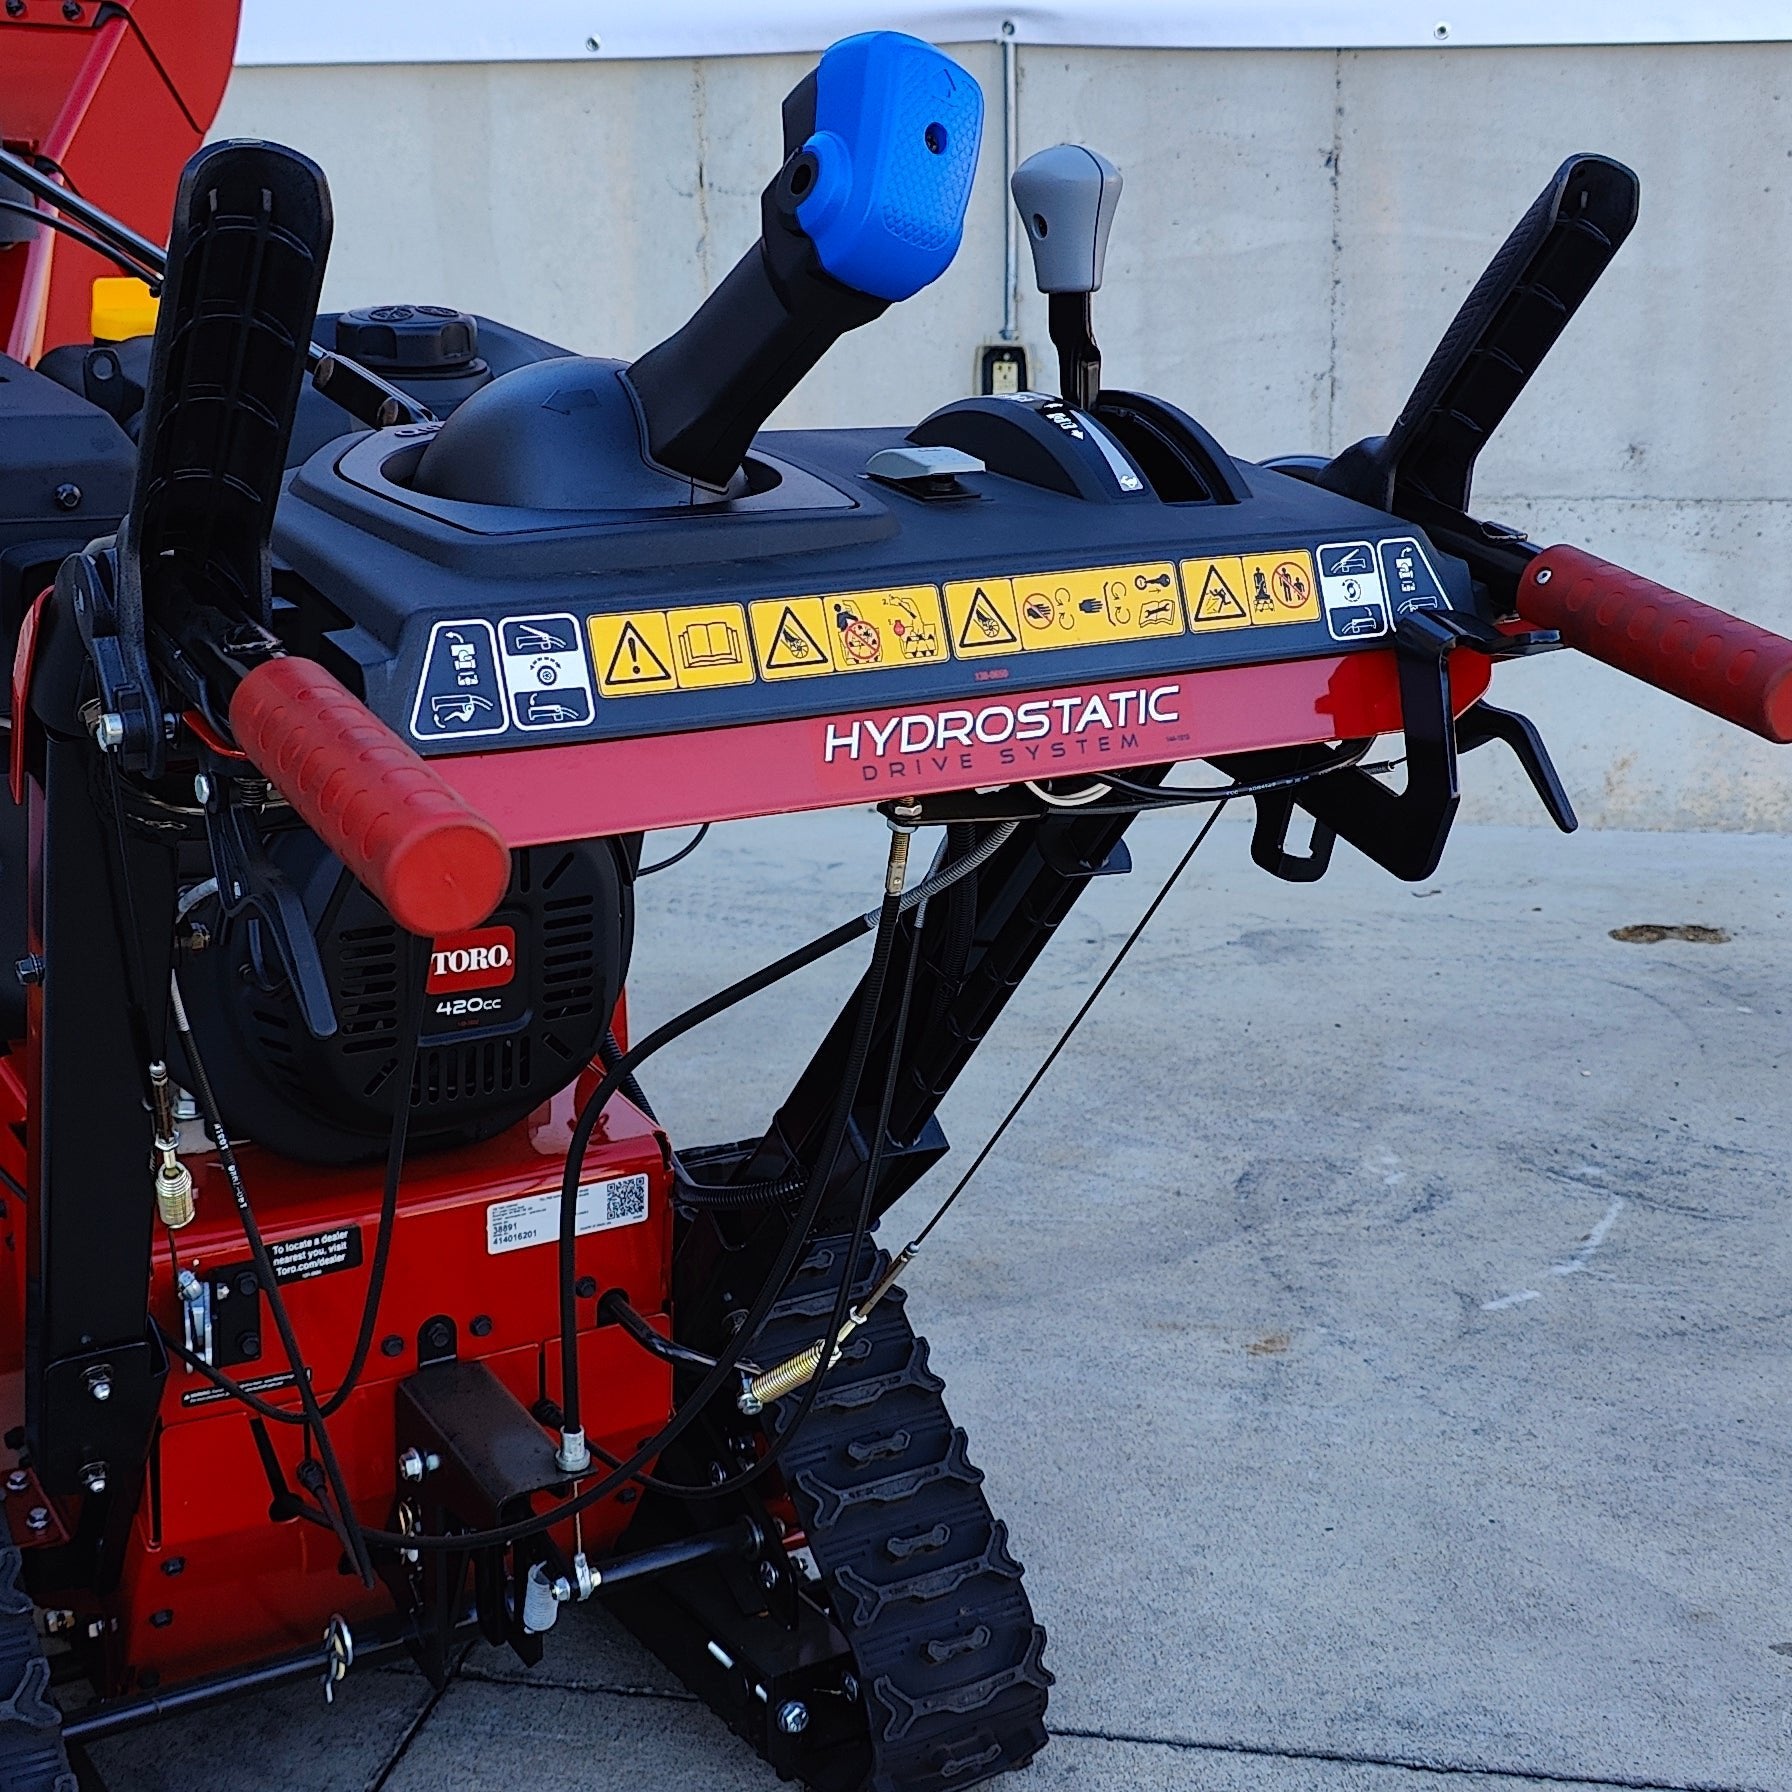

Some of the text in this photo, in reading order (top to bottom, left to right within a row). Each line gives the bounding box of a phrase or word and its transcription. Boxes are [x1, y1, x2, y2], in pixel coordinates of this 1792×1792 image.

[824, 685, 1180, 762] HYDROSTATIC
[862, 733, 1139, 781] DRIVE SYSTEM
[493, 1222, 518, 1235] 38891
[493, 1229, 537, 1245] 414016201
[272, 1230, 349, 1256] To locate a dealer
[272, 1241, 347, 1267] nearest you, visit
[275, 1253, 346, 1277] Toro.com/dealer
